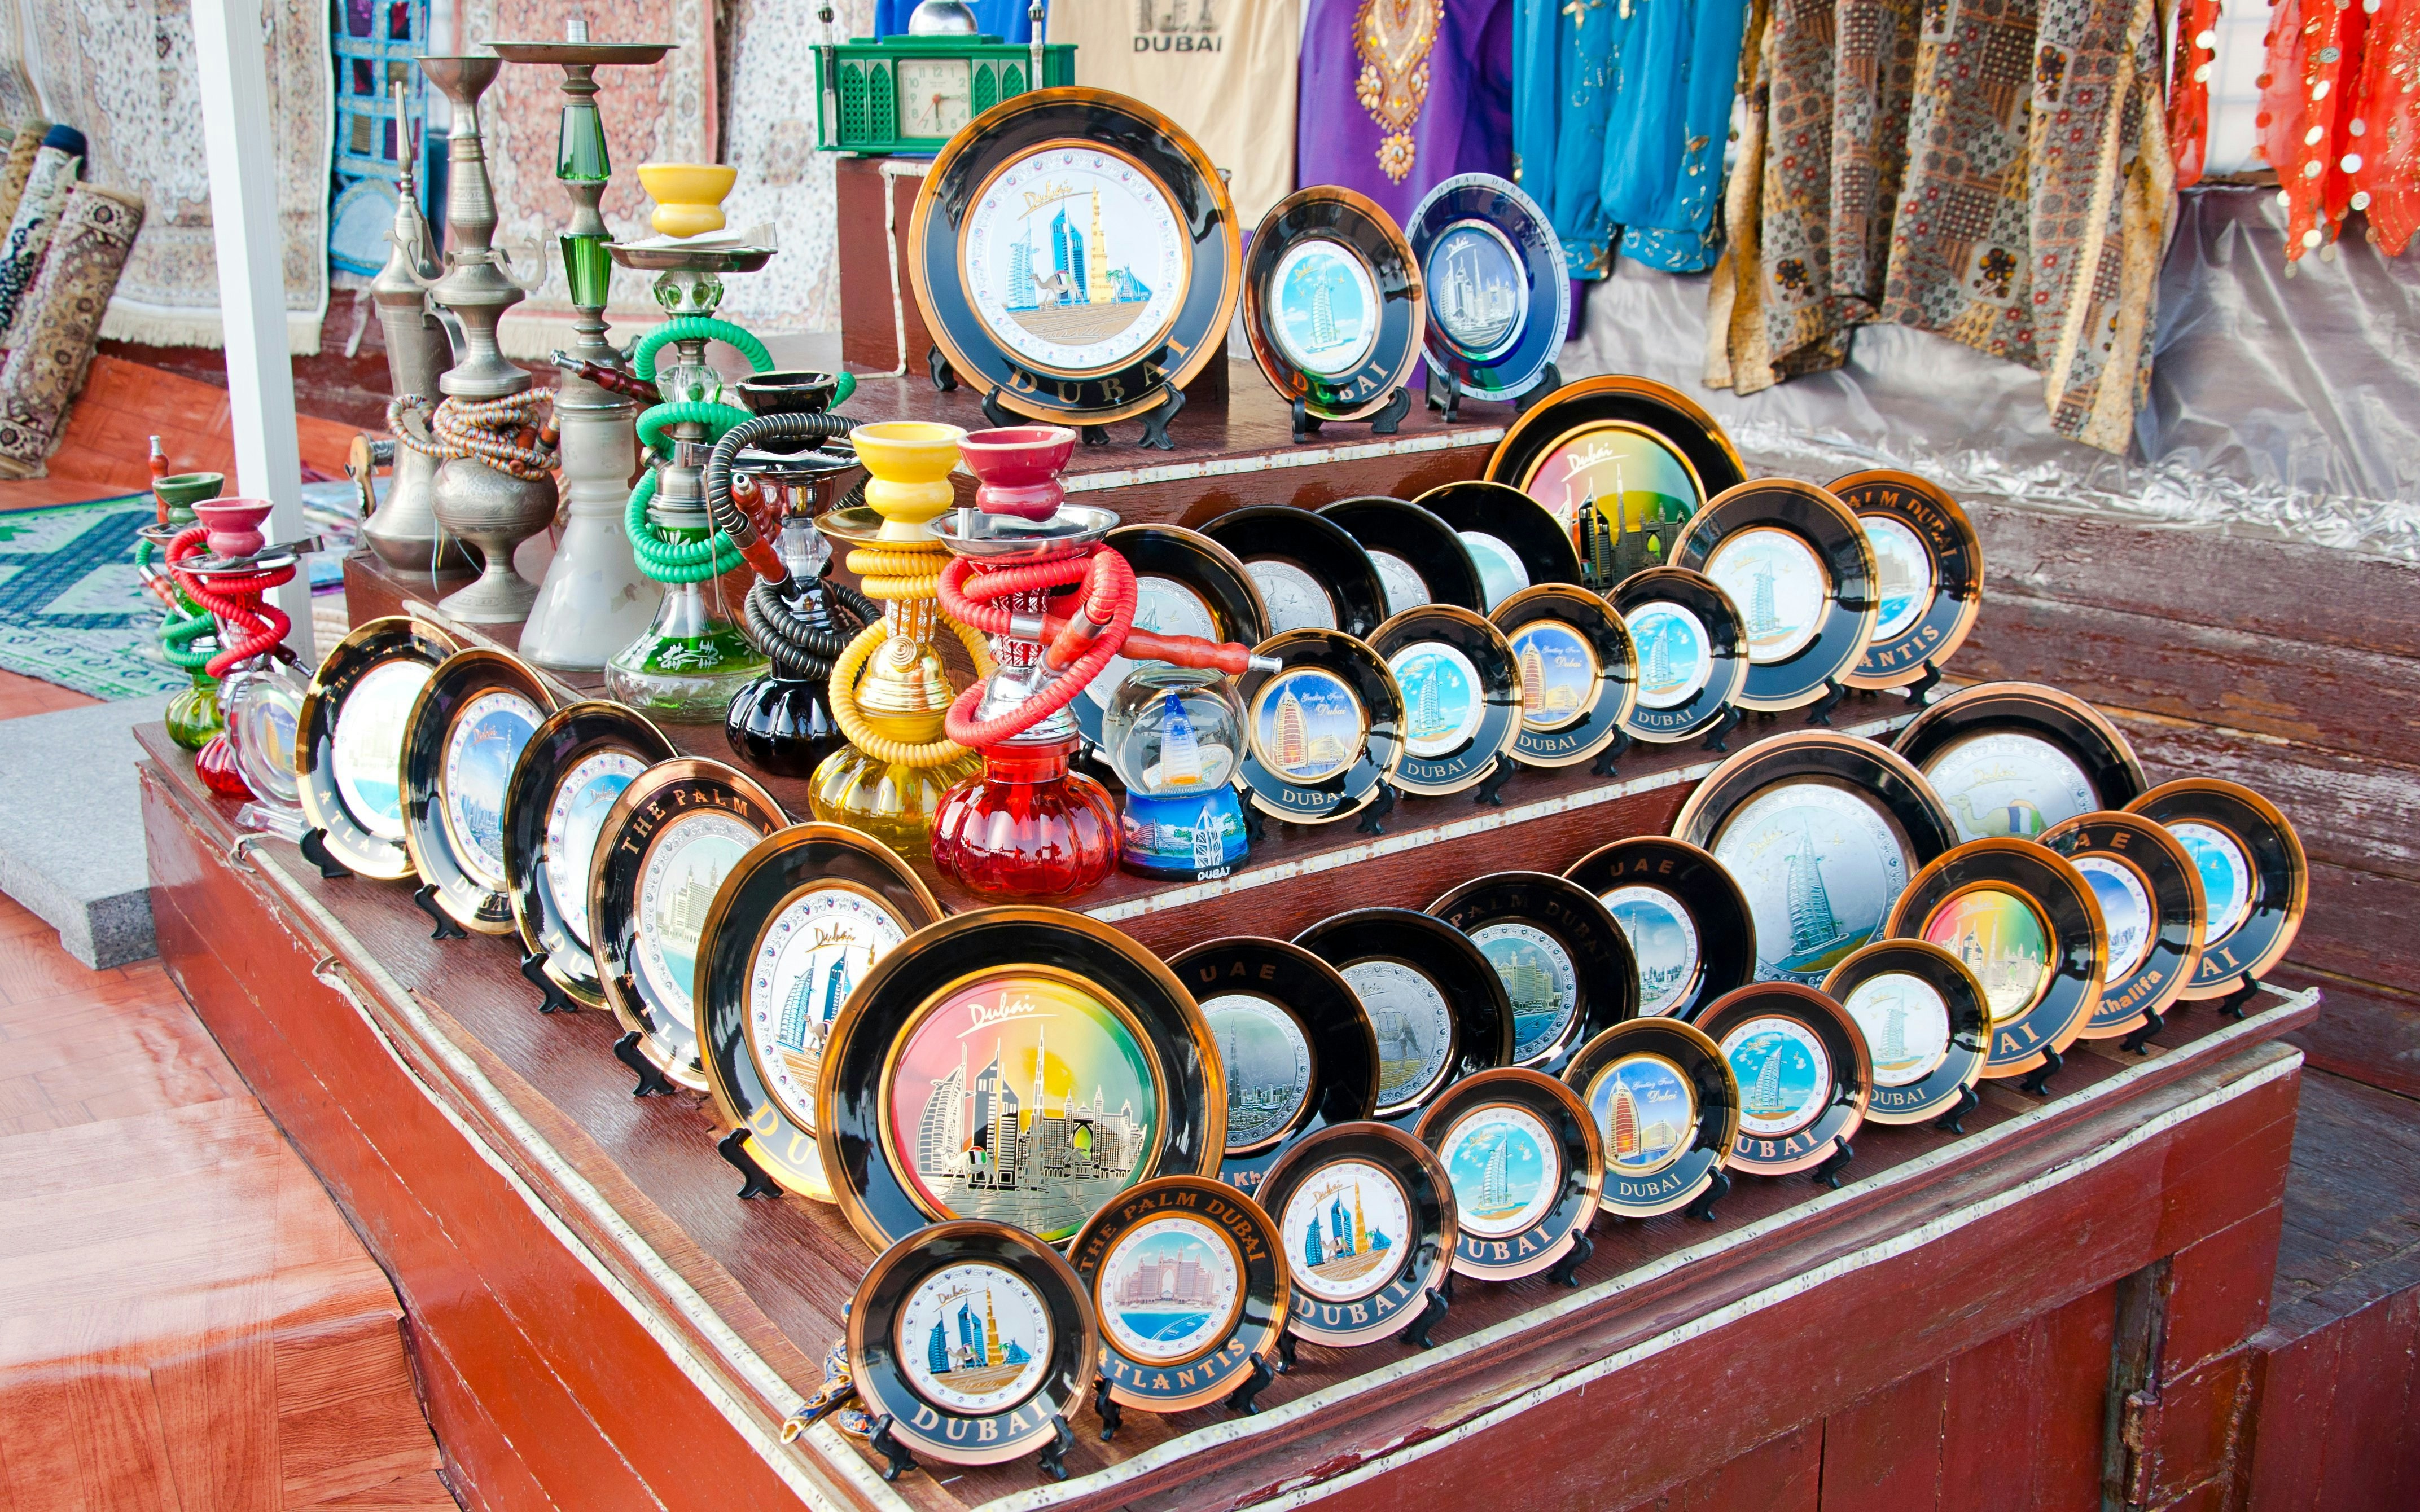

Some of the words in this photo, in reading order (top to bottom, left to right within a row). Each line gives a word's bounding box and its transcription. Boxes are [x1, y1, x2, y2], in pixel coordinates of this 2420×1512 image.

[1133, 36, 1221, 52] DUBAI
[932, 67, 943, 77] 12
[1437, 175, 1477, 196] DUBAI
[1492, 178, 1531, 205] DUBAI
[1540, 216, 1565, 265] DUBAI
[1006, 335, 1190, 404] DUBAI
[1291, 360, 1389, 401] DUBAI
[1567, 442, 1614, 471] Dubai
[1857, 625, 1939, 667] ANTIS
[1554, 656, 1583, 668] Dubai
[1316, 703, 1347, 717] Dubai
[1638, 710, 1694, 727] DUBAI
[1519, 735, 1577, 751] DUBAI
[1407, 757, 1468, 777] DUBAI
[1282, 788, 1348, 806] DUBAI
[621, 801, 666, 855] THE
[673, 788, 749, 818] PALM
[1196, 866, 1231, 882] DUBAI
[1610, 857, 1674, 877] UAE
[1200, 961, 1277, 982] UAE
[2094, 969, 2163, 1016] Khalifa
[967, 992, 1036, 1027] Dubai
[1647, 1089, 1678, 1103] Dubai
[1735, 1128, 1820, 1158] UBAI
[1619, 1173, 1684, 1197] DUBAI
[1079, 1224, 1117, 1272] THE
[1123, 1192, 1198, 1221] PALM
[1205, 1199, 1266, 1262] DUBAI
[1294, 1280, 1411, 1325] DUBAI
[1098, 1338, 1246, 1390] ATLANTIS
[910, 1397, 1048, 1442] DUBAI
